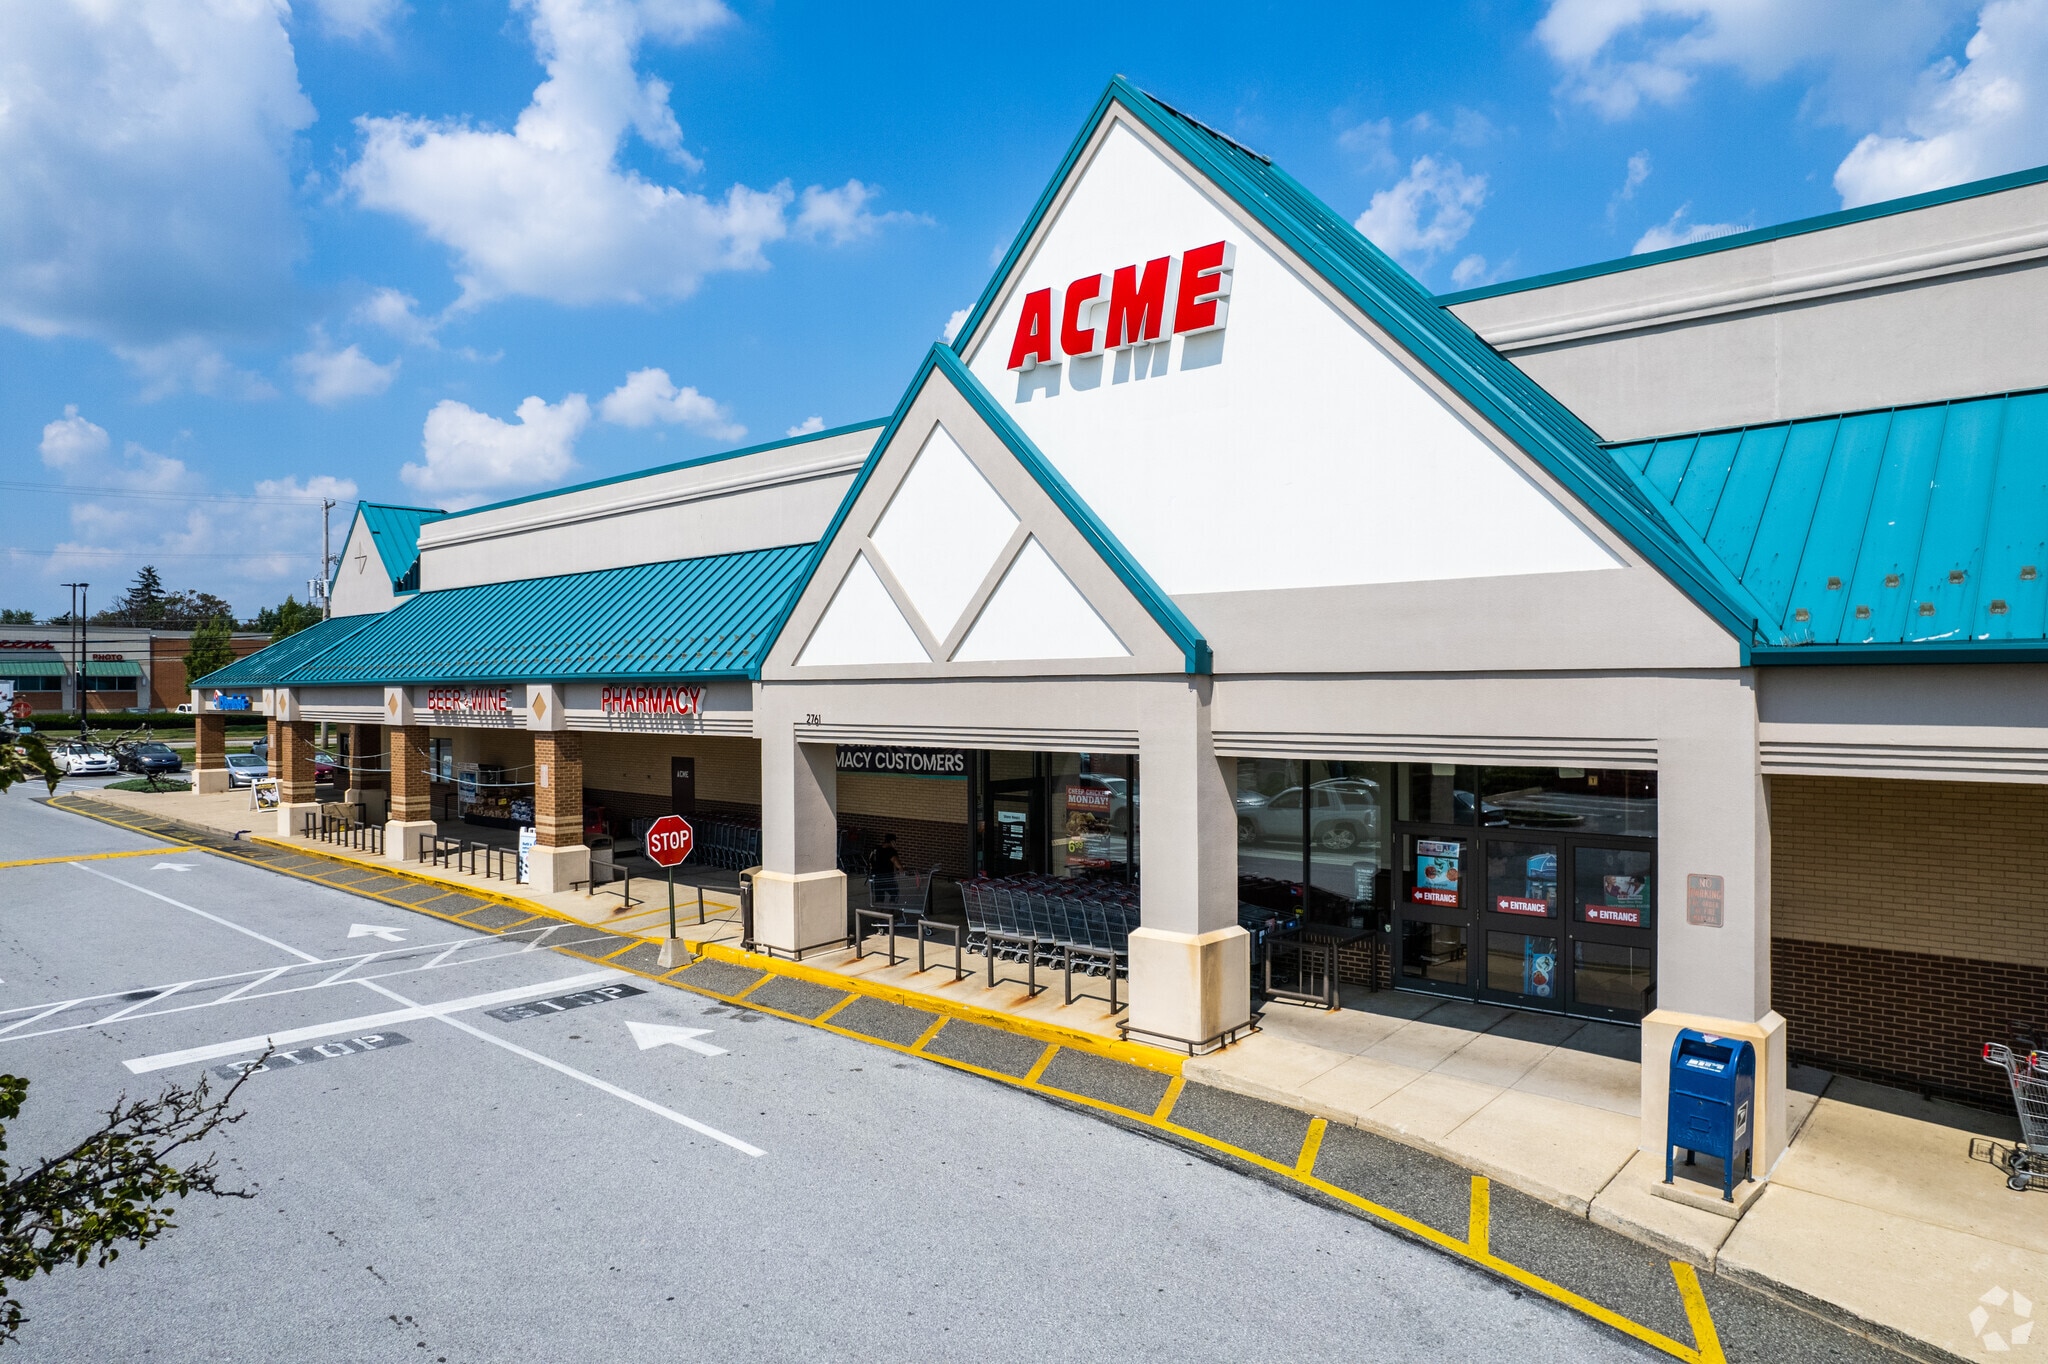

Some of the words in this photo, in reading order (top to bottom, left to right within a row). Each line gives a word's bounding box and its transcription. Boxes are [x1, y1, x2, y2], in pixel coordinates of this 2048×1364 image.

[1006, 240, 1234, 372] ACME
[92, 653, 124, 662] PHOTO
[427, 688, 461, 711] BEER
[470, 688, 507, 711] WINE
[601, 686, 702, 715] PHARMACY
[806, 713, 822, 727] 2761
[875, 752, 964, 772] CUSTOMERS
[1068, 795, 1109, 805] MONDAY!
[651, 830, 690, 852] STOP
[1699, 878, 1713, 888] NO
[1424, 892, 1457, 903] ENTRANCE
[1509, 901, 1546, 913] ENTRANCE
[1600, 910, 1638, 923] ENTRANCE
[502, 986, 623, 1019] STOP
[226, 1033, 385, 1076] STOP
